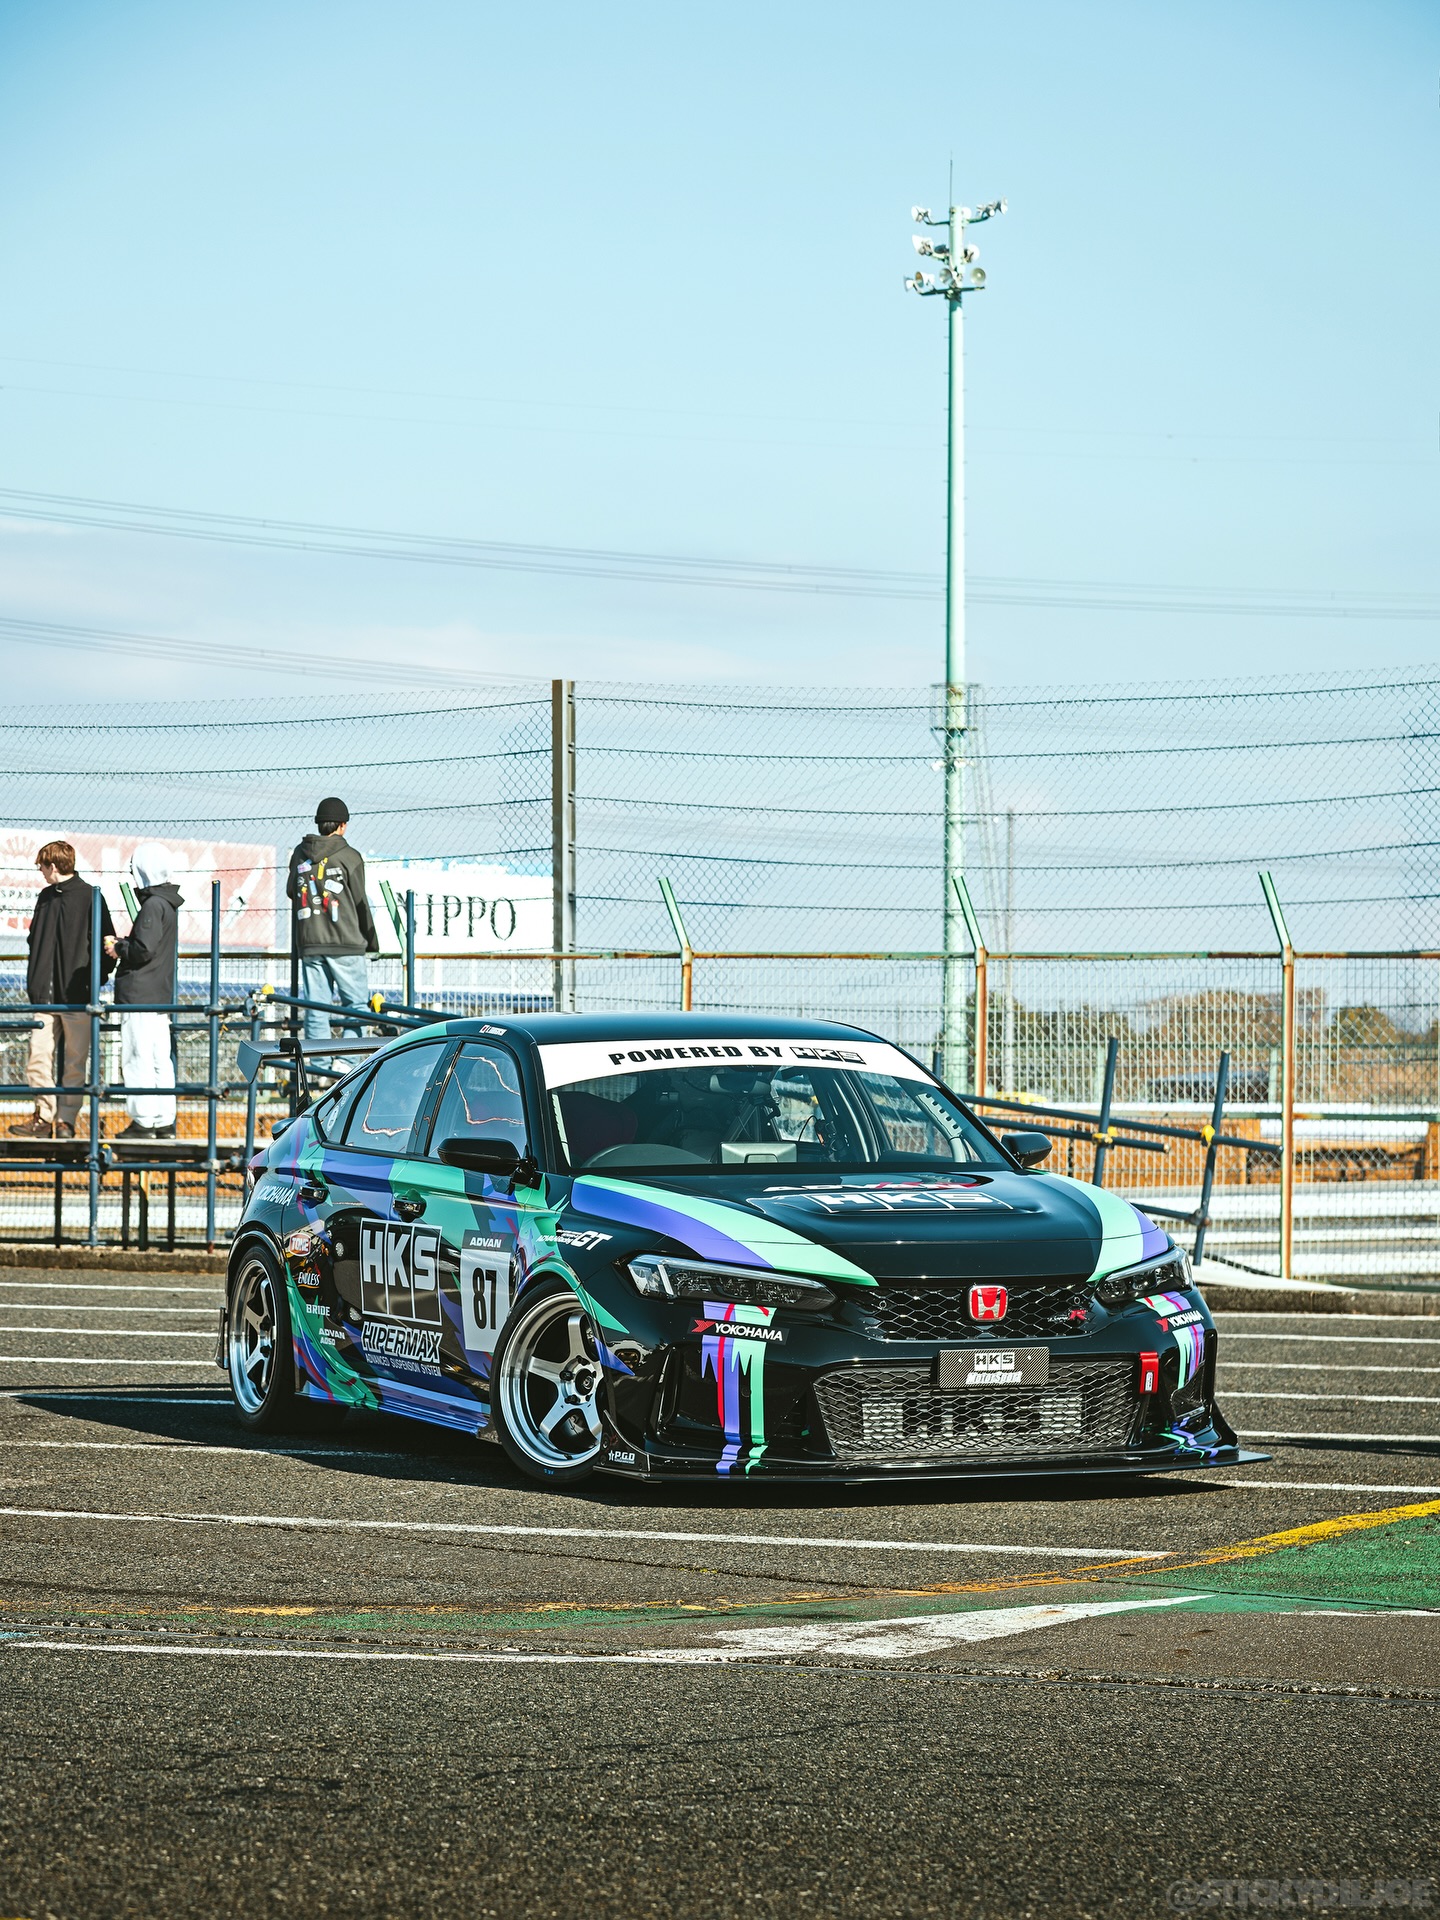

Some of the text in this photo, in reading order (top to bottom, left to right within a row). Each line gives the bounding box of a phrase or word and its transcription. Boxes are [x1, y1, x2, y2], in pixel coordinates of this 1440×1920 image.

[608, 1046, 867, 1065] POWERED BY HKS
[815, 1192, 997, 1207] HKS
[470, 1236, 502, 1248] ADVAN
[570, 1230, 614, 1251] GT
[361, 1227, 439, 1293] HKS
[298, 1271, 321, 1286] ENDLESS
[472, 1267, 497, 1330] 87
[306, 1304, 331, 1317] BRIDE
[1167, 1310, 1204, 1327] YOKOHAMA
[319, 1327, 345, 1340] ADVAN
[714, 1323, 783, 1341] YOKOHAMA
[361, 1321, 443, 1364] HIPERMAX
[365, 1353, 442, 1377] ADVANCED SUSPENSION SYSTEM
[975, 1353, 1014, 1367] HKS
